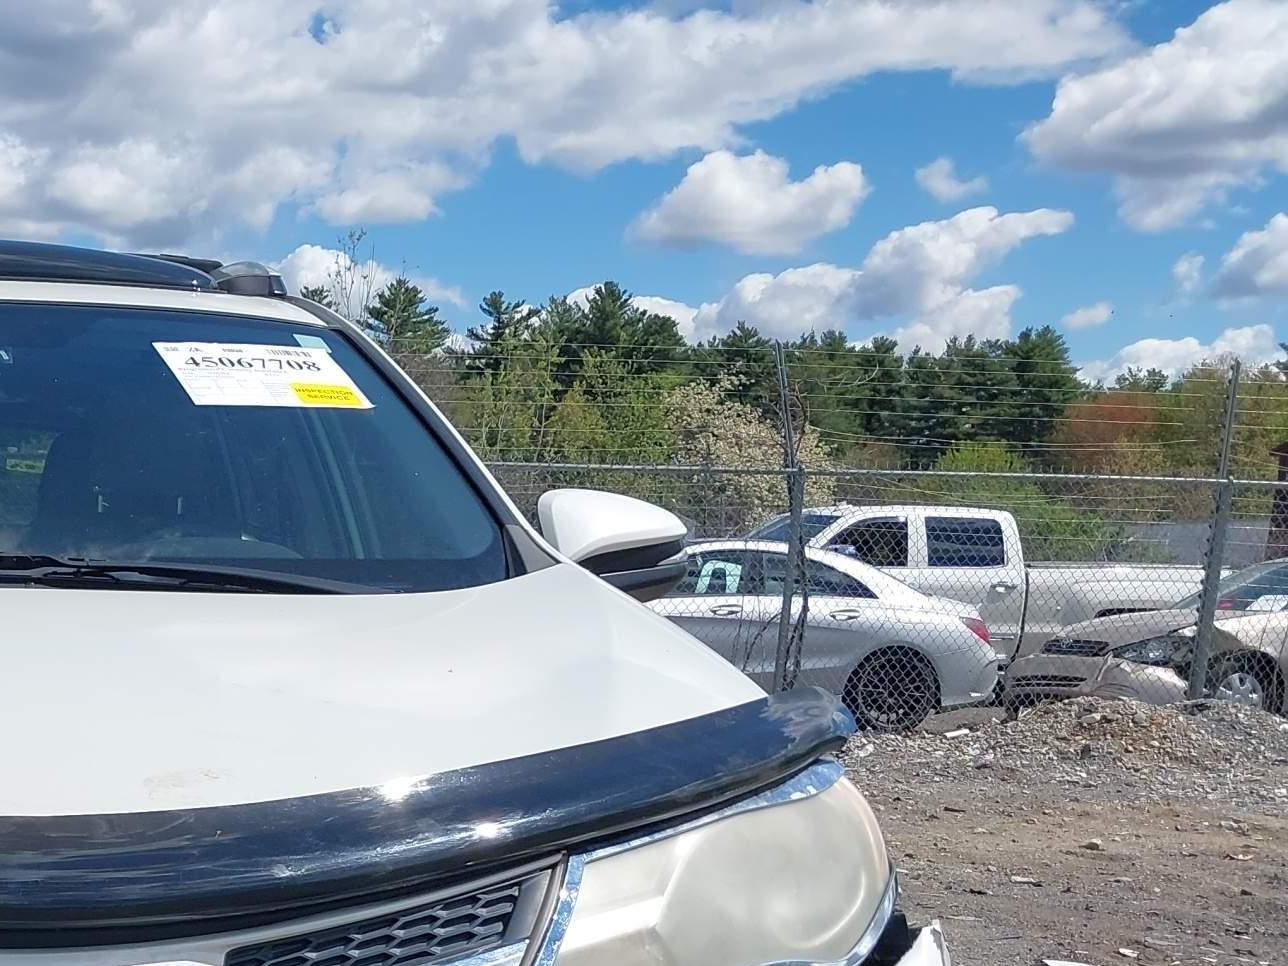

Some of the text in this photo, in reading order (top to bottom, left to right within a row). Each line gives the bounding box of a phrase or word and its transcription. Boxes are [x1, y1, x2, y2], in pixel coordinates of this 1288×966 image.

[184, 356, 321, 372] 45067708
[294, 386, 354, 397] INSPECTION
[307, 393, 351, 401] SERVICE
